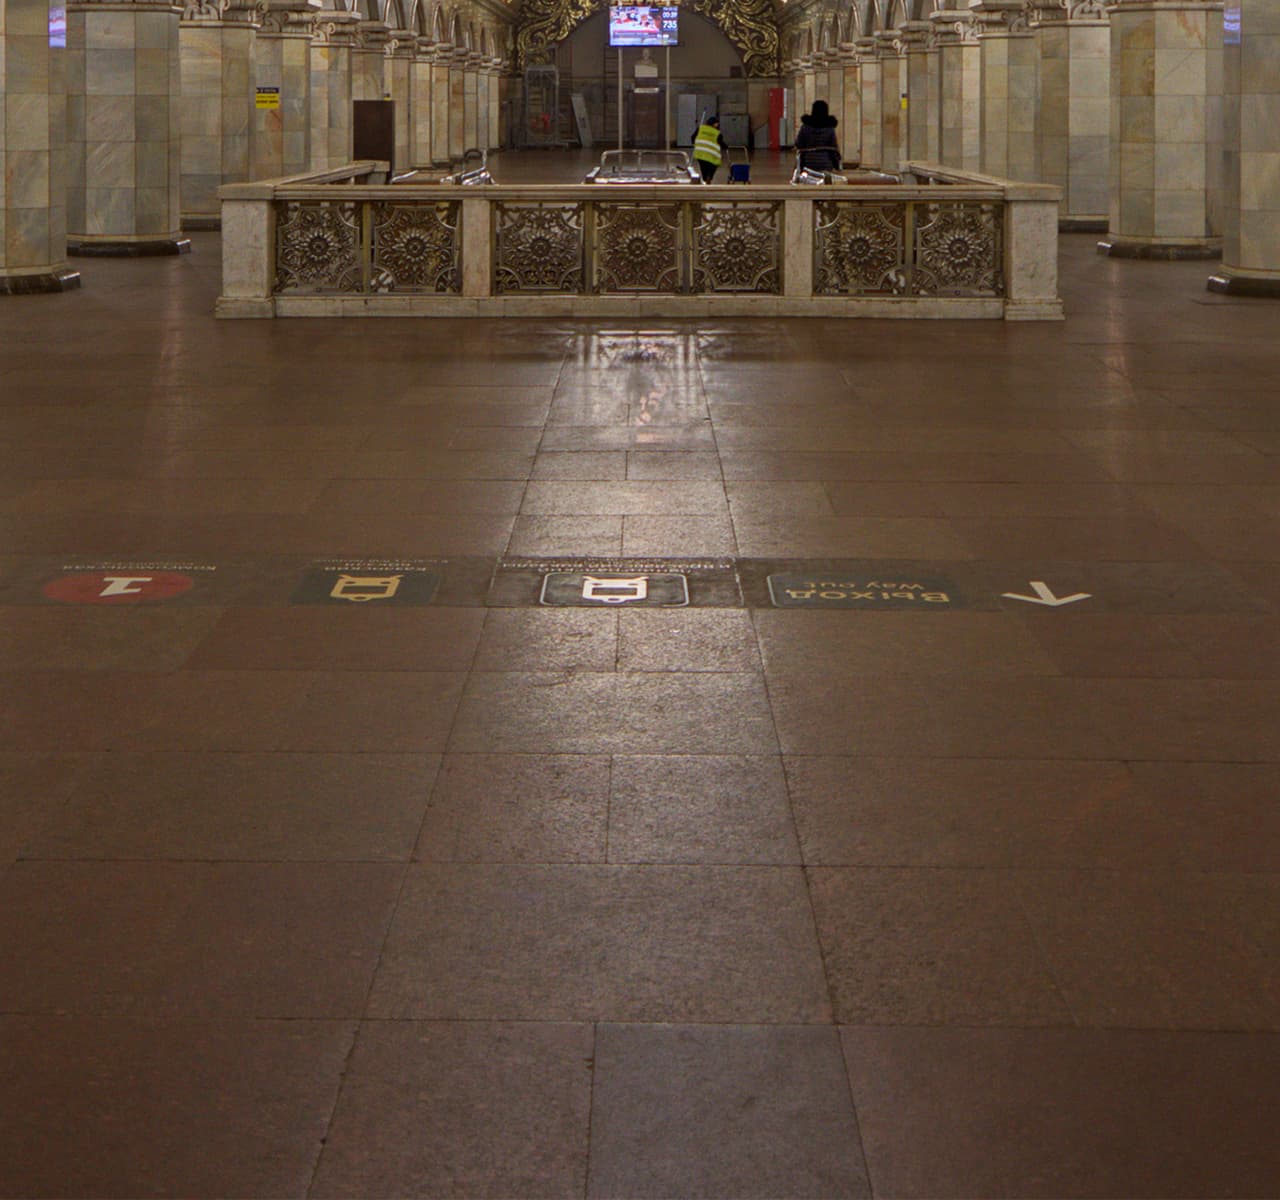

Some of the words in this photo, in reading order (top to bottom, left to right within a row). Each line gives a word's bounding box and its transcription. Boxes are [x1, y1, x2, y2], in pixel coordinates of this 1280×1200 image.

[98, 576, 154, 598] 1
[802, 581, 856, 590] out
[867, 580, 926, 591] Way
[785, 588, 951, 603] Выход
